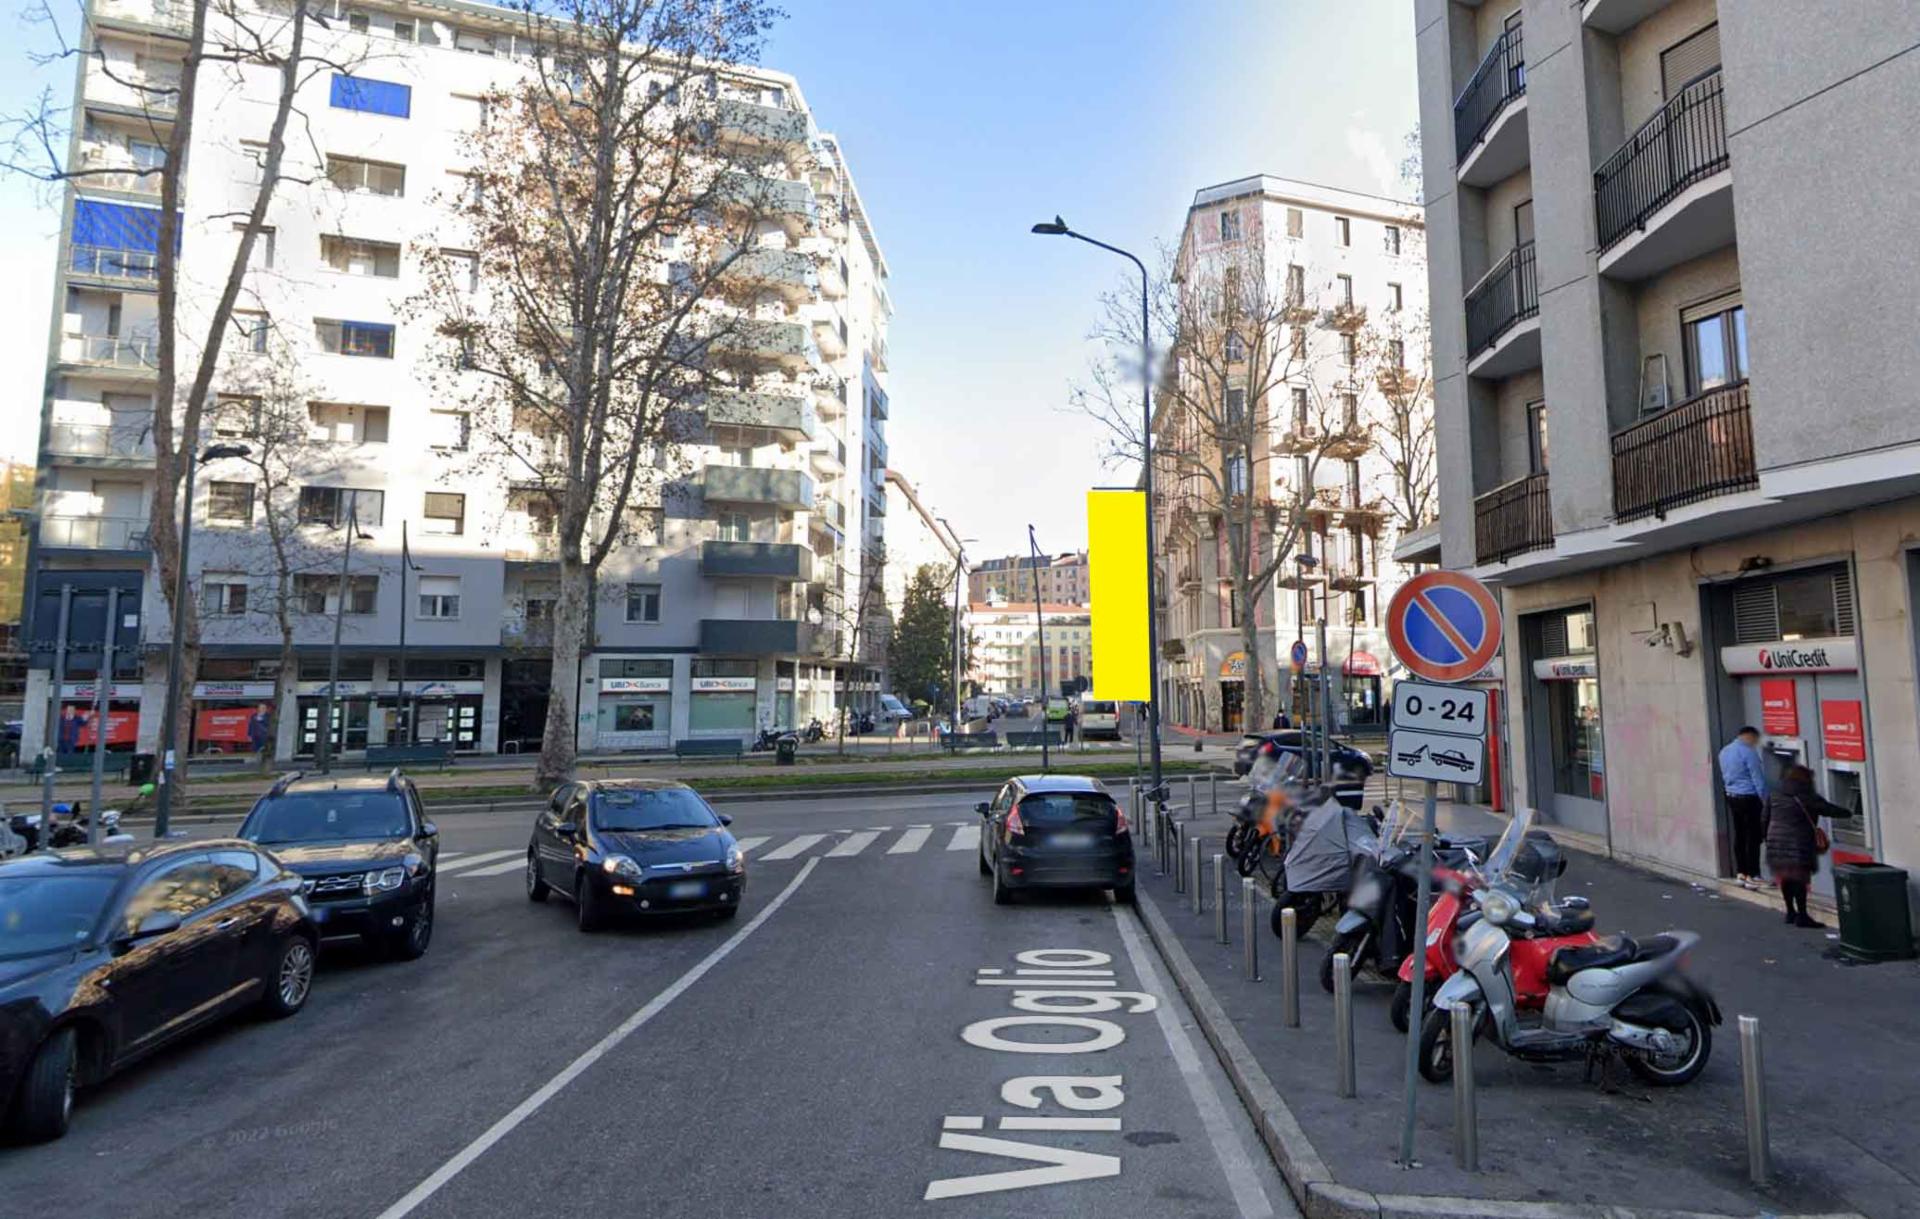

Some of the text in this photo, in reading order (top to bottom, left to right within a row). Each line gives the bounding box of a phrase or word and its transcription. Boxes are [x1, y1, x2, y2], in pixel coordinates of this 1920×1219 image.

[1772, 649, 1830, 668] UniCredit
[1406, 695, 1422, 716] 0
[1441, 699, 1475, 723] 24
